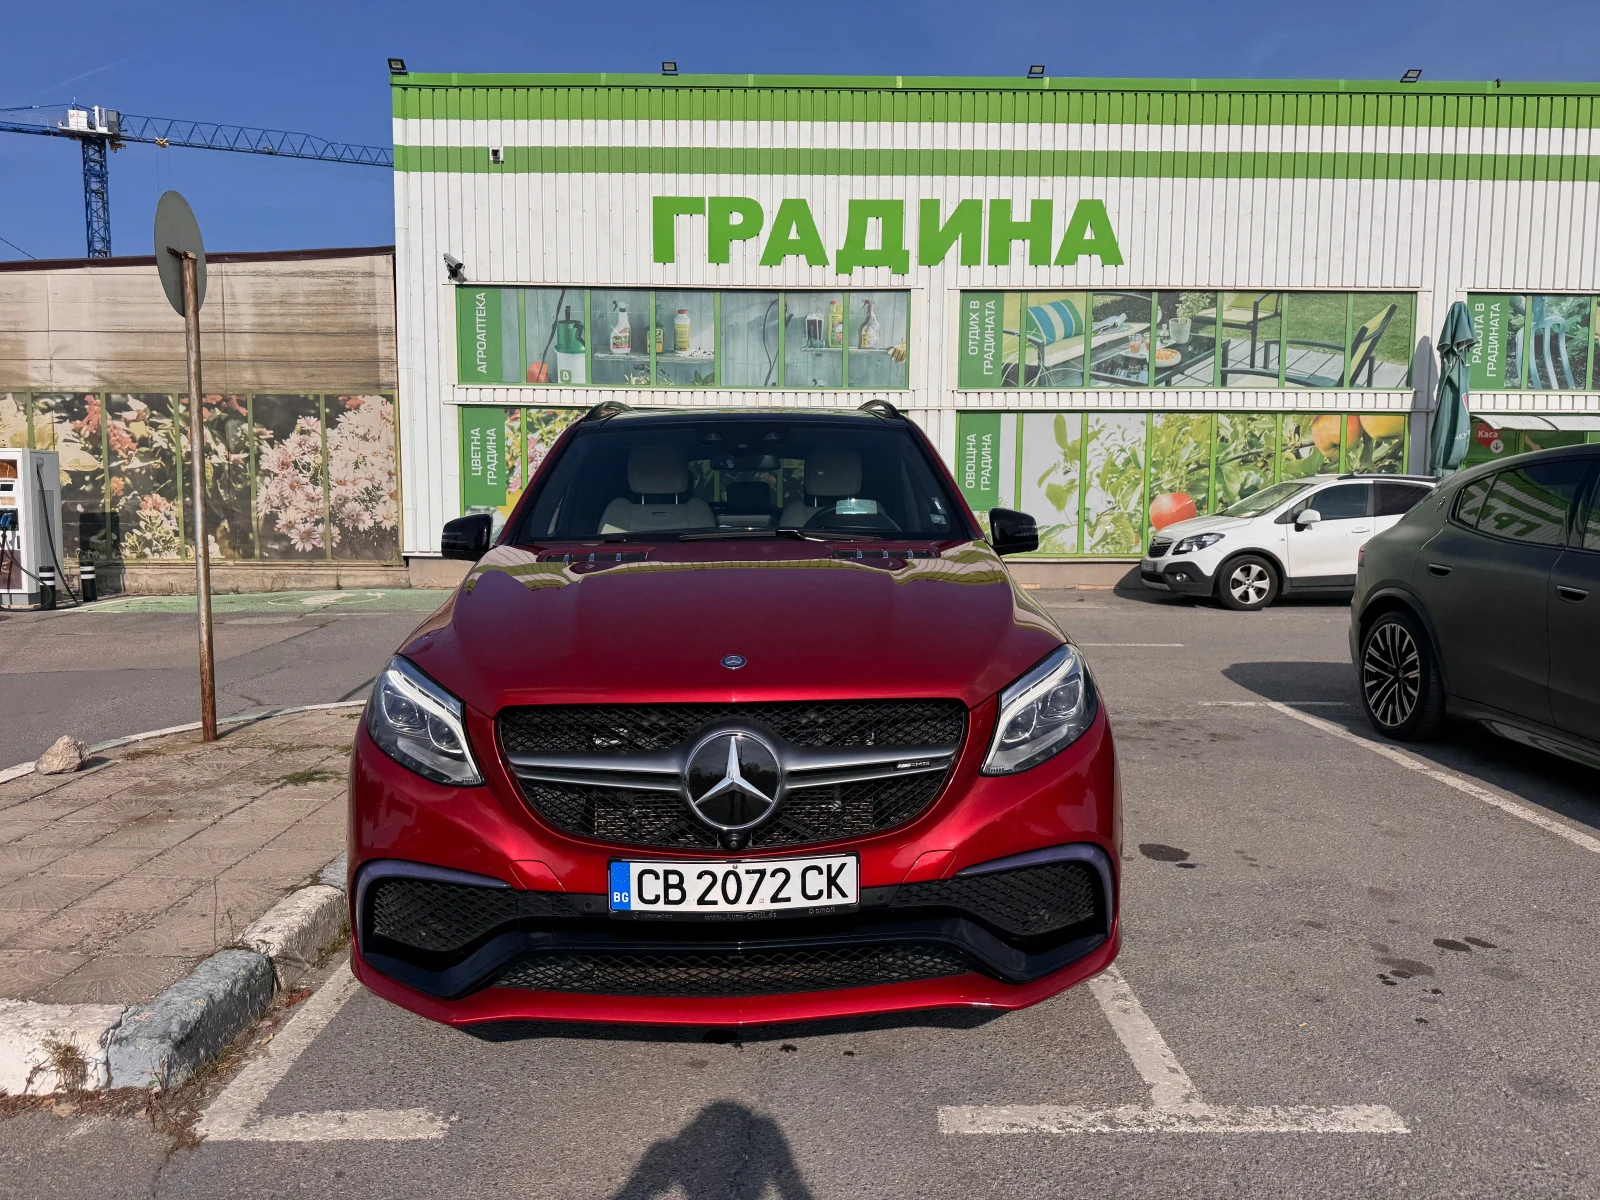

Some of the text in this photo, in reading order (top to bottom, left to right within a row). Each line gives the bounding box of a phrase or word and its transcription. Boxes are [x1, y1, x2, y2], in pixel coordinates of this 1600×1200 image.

[653, 197, 1123, 275] ГРАДИНА
[476, 292, 487, 373] АГРОАПТЕКА
[968, 300, 980, 355] ОТДИХ В
[1475, 303, 1485, 311] В
[983, 300, 996, 375] ГРАДИНАТА
[1487, 303, 1501, 377] ГРАДИНАТА
[471, 428, 482, 476] ЦВЕТНА
[487, 428, 497, 485] ГРАДИНА
[965, 434, 977, 489] ОВОЩНА
[980, 434, 992, 490] ГРАДИНА
[613, 892, 629, 903] BG
[637, 862, 849, 906] CB 2072 CK
